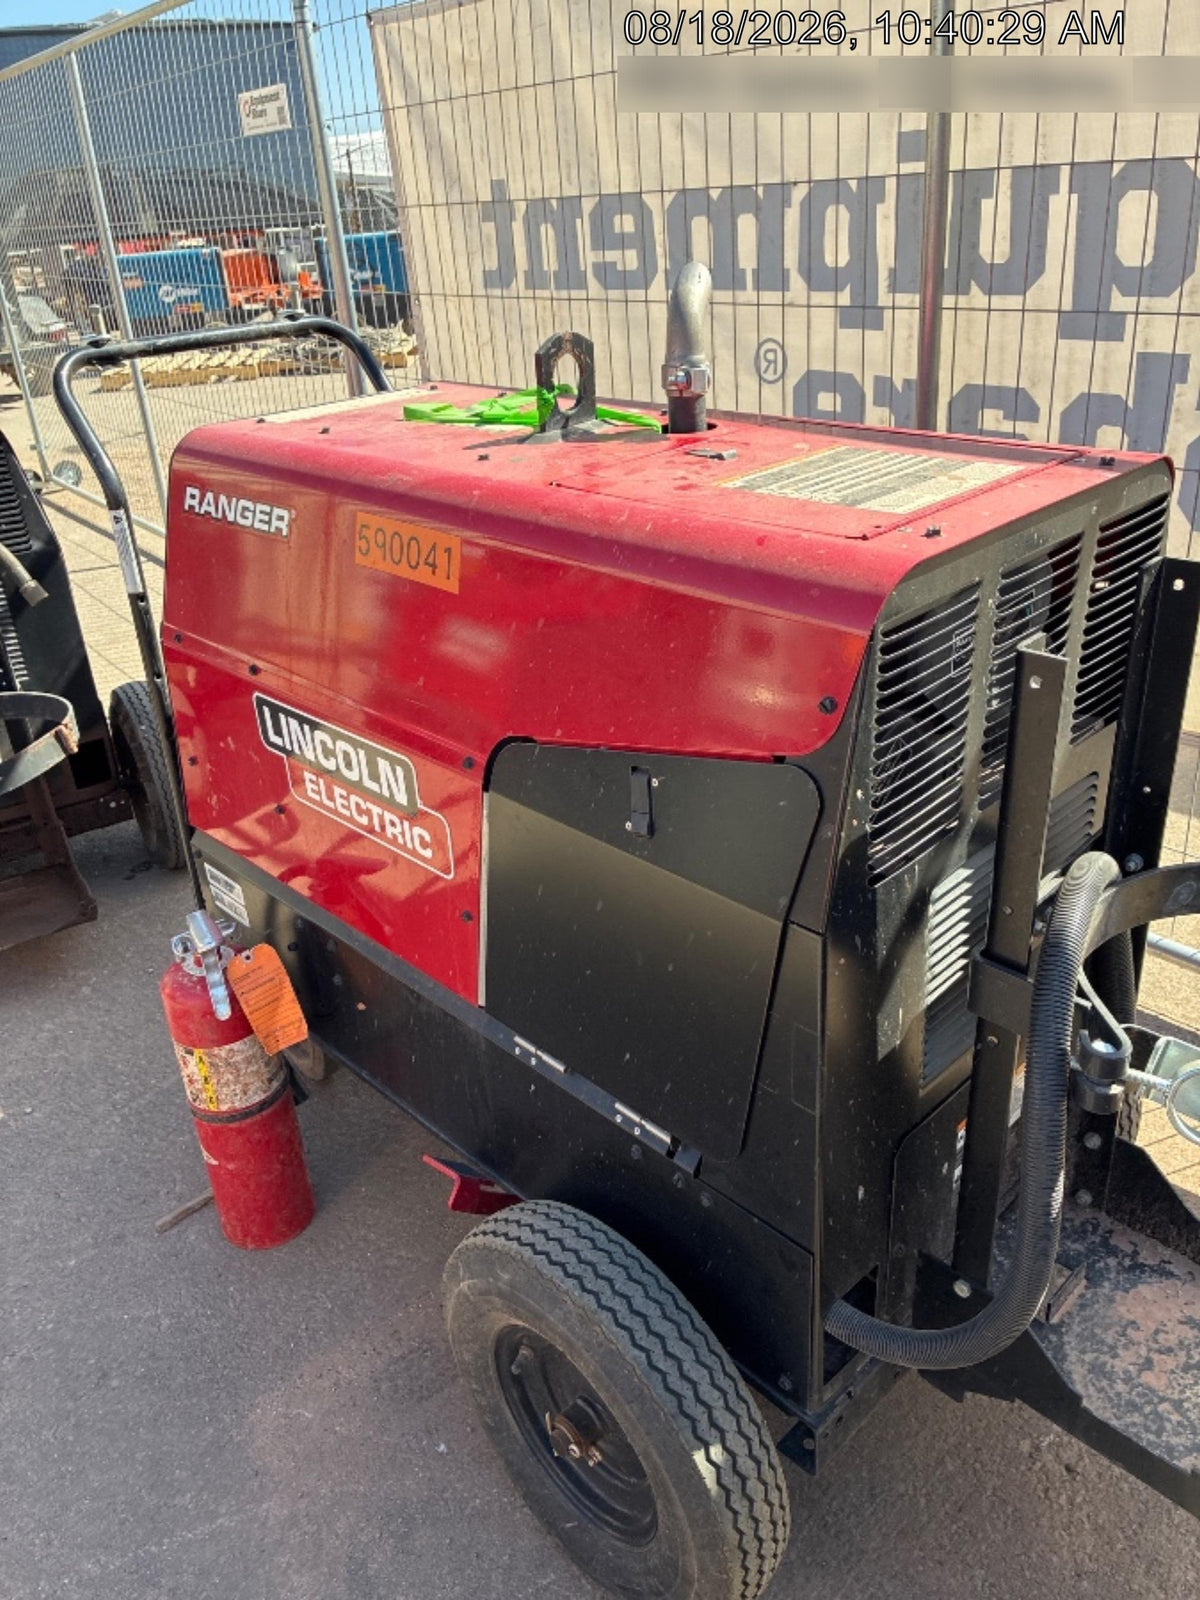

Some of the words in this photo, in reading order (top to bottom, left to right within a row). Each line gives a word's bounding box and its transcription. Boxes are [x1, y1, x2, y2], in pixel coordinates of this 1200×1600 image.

[184, 486, 290, 536] RANGER
[358, 524, 458, 583] 590041
[262, 706, 409, 807] LINCOLN
[304, 771, 434, 859] ELECTRIC
